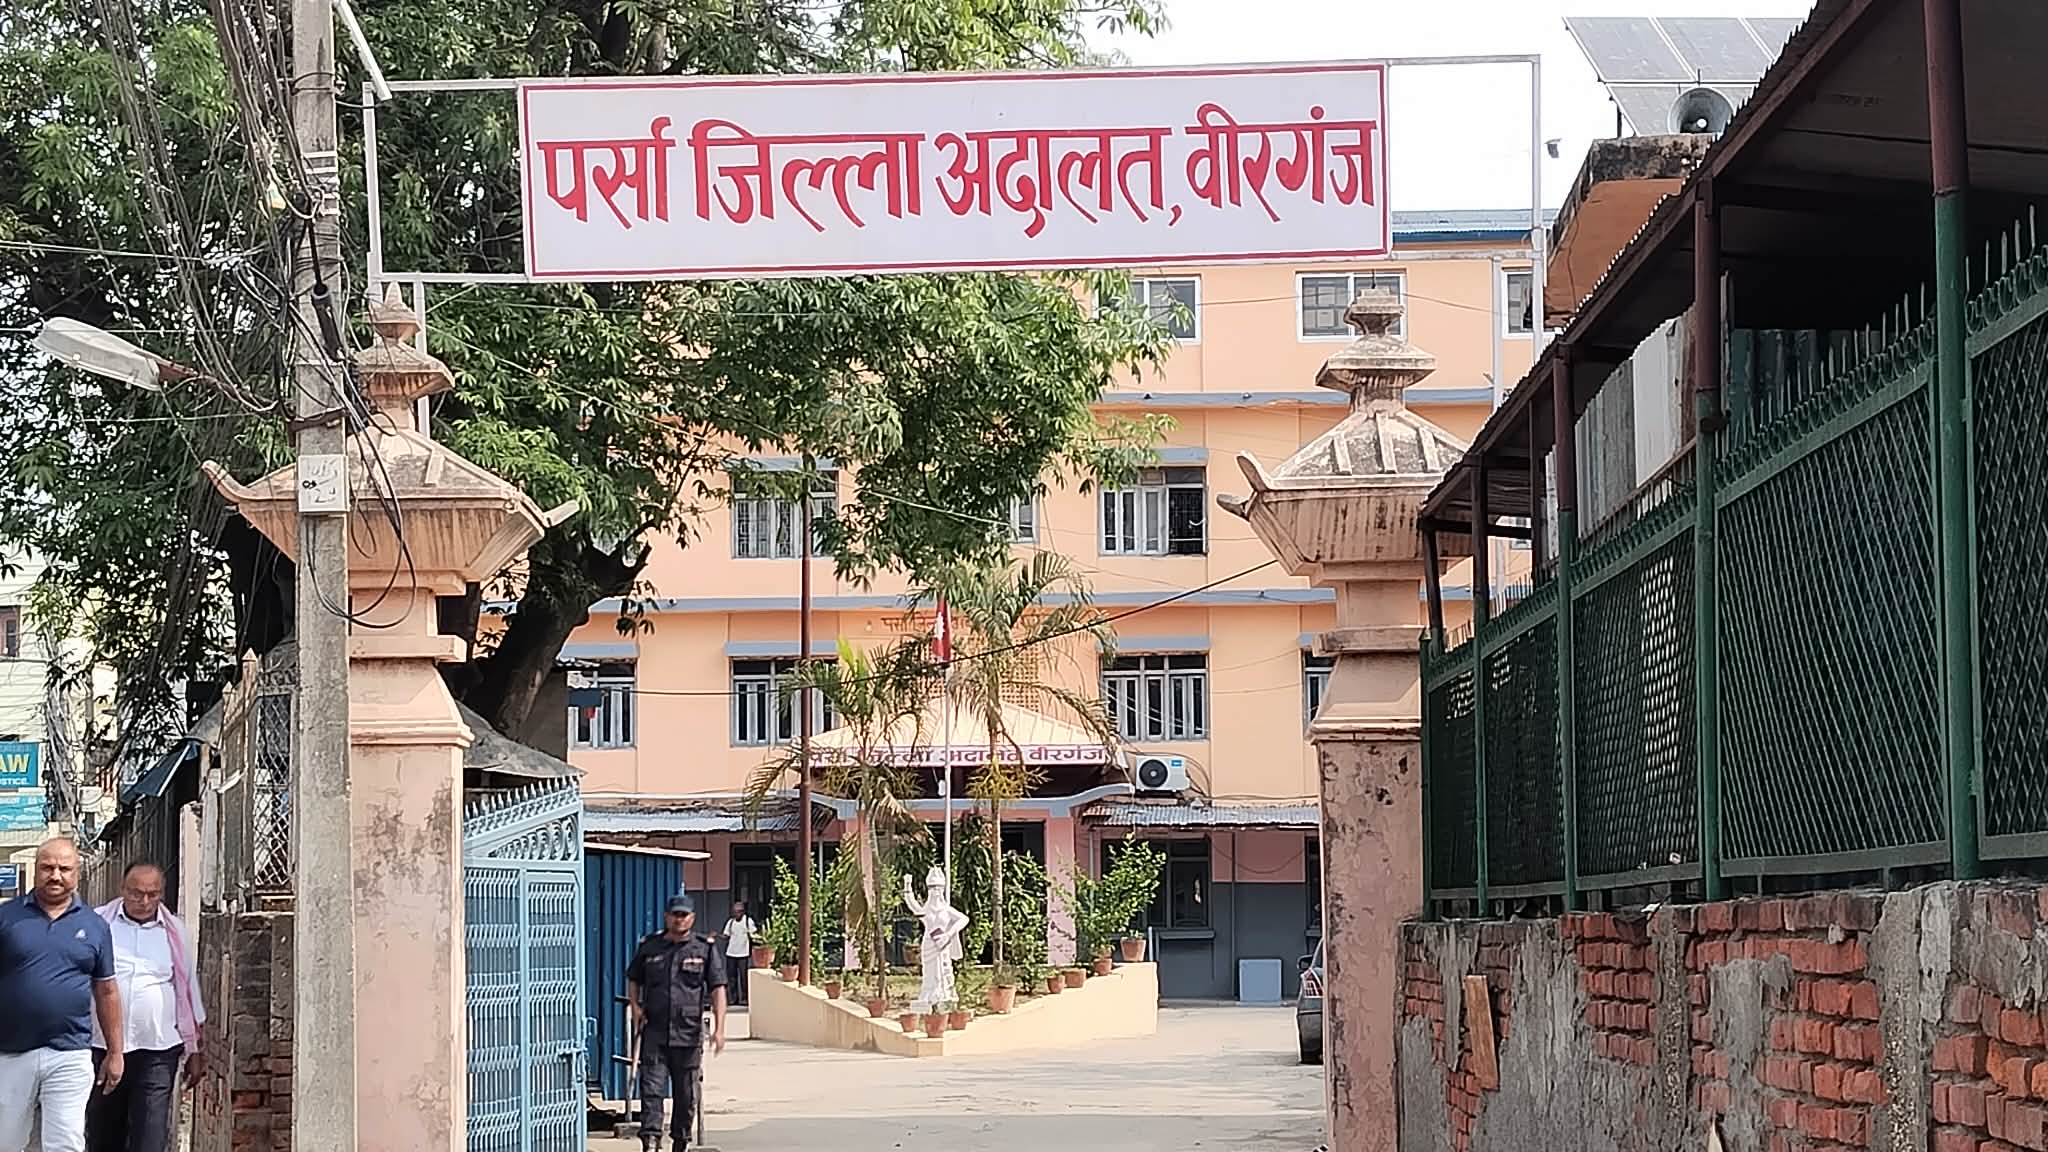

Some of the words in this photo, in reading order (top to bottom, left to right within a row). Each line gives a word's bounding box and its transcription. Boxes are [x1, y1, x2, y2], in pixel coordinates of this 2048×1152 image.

[538, 117, 675, 231] पर्सा
[688, 120, 926, 231] जिल्ला
[935, 128, 1182, 236] अदालत,
[1186, 104, 1376, 223] वीरगंज
[1030, 744, 1103, 762] वीरगंज
